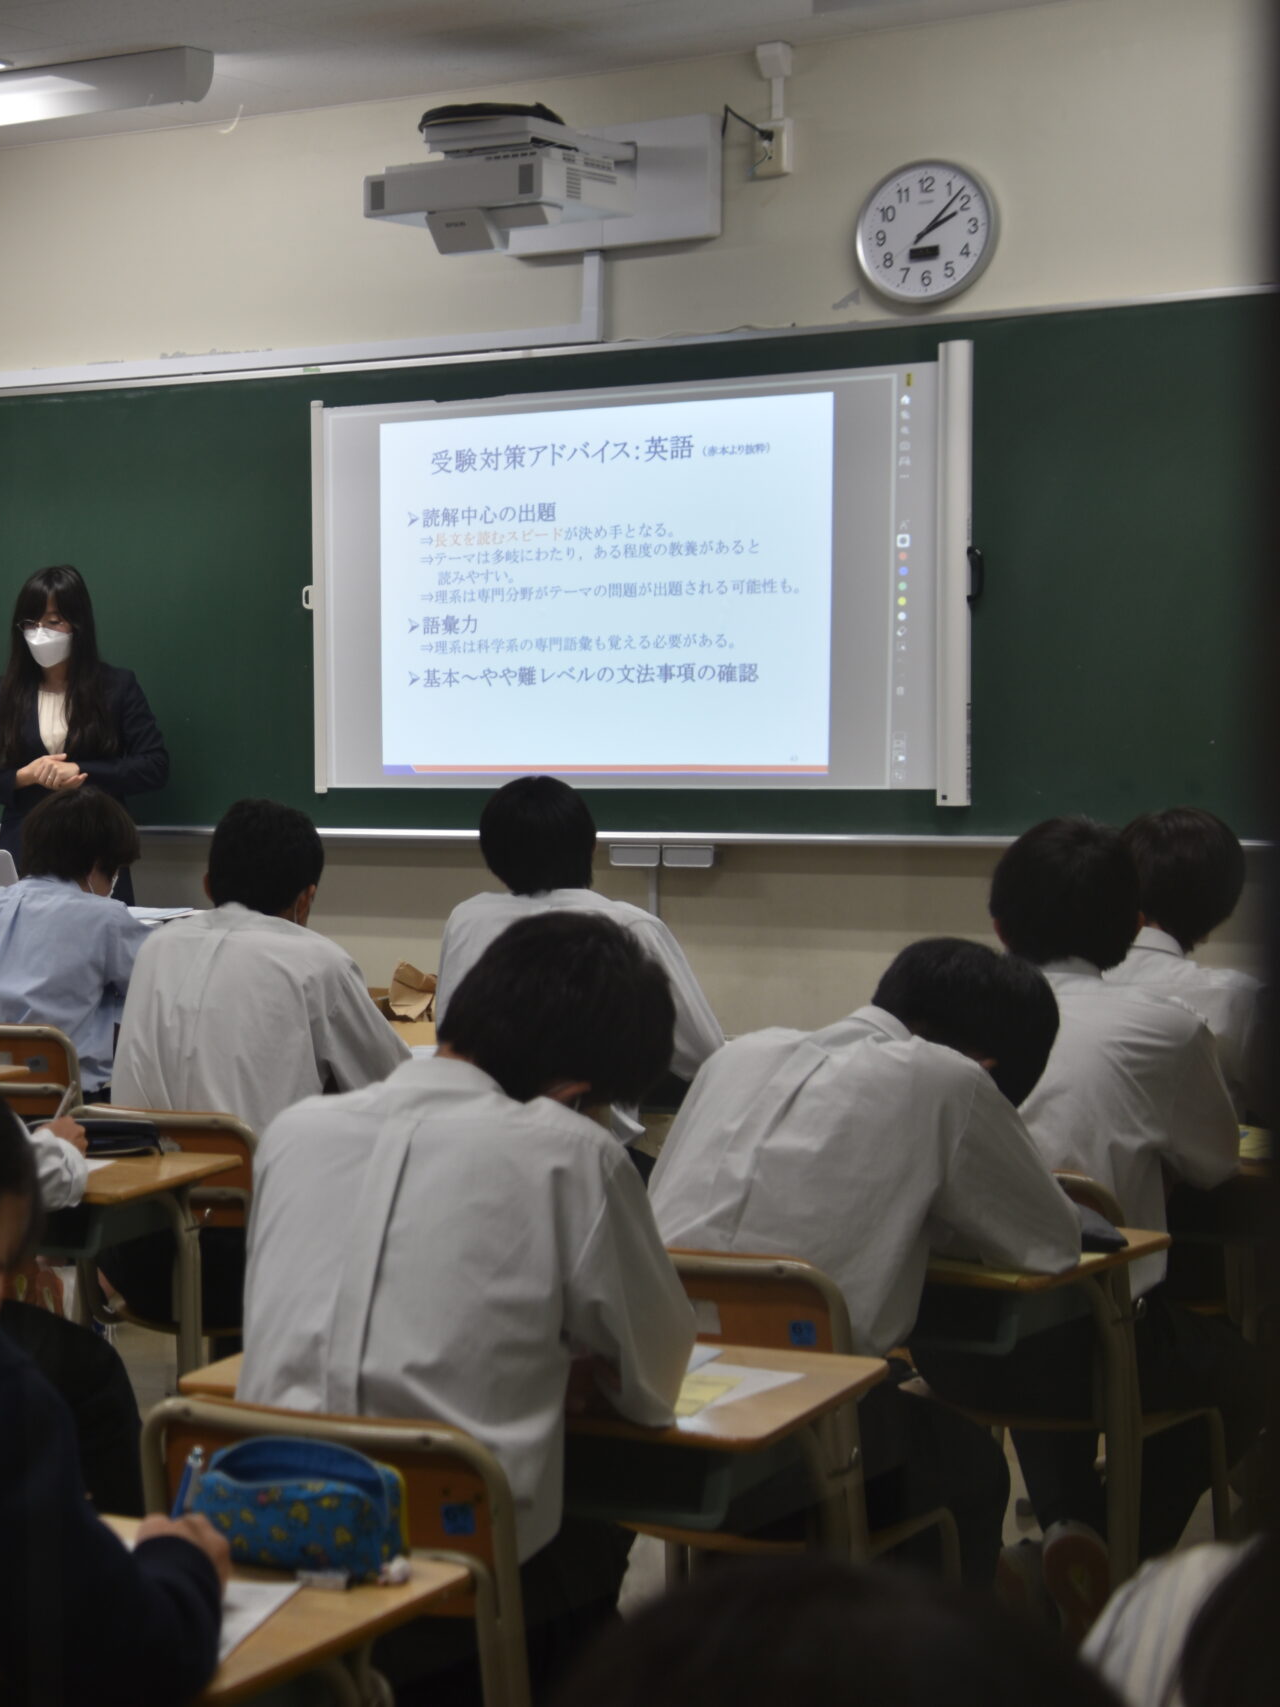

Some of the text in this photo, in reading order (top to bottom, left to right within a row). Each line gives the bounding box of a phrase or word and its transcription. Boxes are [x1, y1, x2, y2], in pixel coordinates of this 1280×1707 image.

[918, 176, 935, 193] 12
[946, 180, 953, 196] 1
[896, 187, 910, 203] 11
[959, 194, 970, 211] 2
[880, 205, 896, 222] 10
[967, 217, 979, 234] 3
[875, 230, 887, 247] 9
[959, 242, 970, 258] 4
[883, 252, 894, 269] 8
[899, 267, 910, 284] 7
[944, 261, 955, 278] 5
[921, 270, 932, 287] 6
[422, 501, 557, 528] 読解中心の出題
[434, 523, 675, 548] 長文を読むスピードが決め手となる。
[438, 569, 515, 586] 読みやすい。
[434, 578, 800, 604] 理系は専門分野がテーマの問題が出題される可能性も。
[423, 614, 478, 635] 語彙力
[434, 633, 735, 655] 理系は科学系の専門語彙も覚える必要がある。
